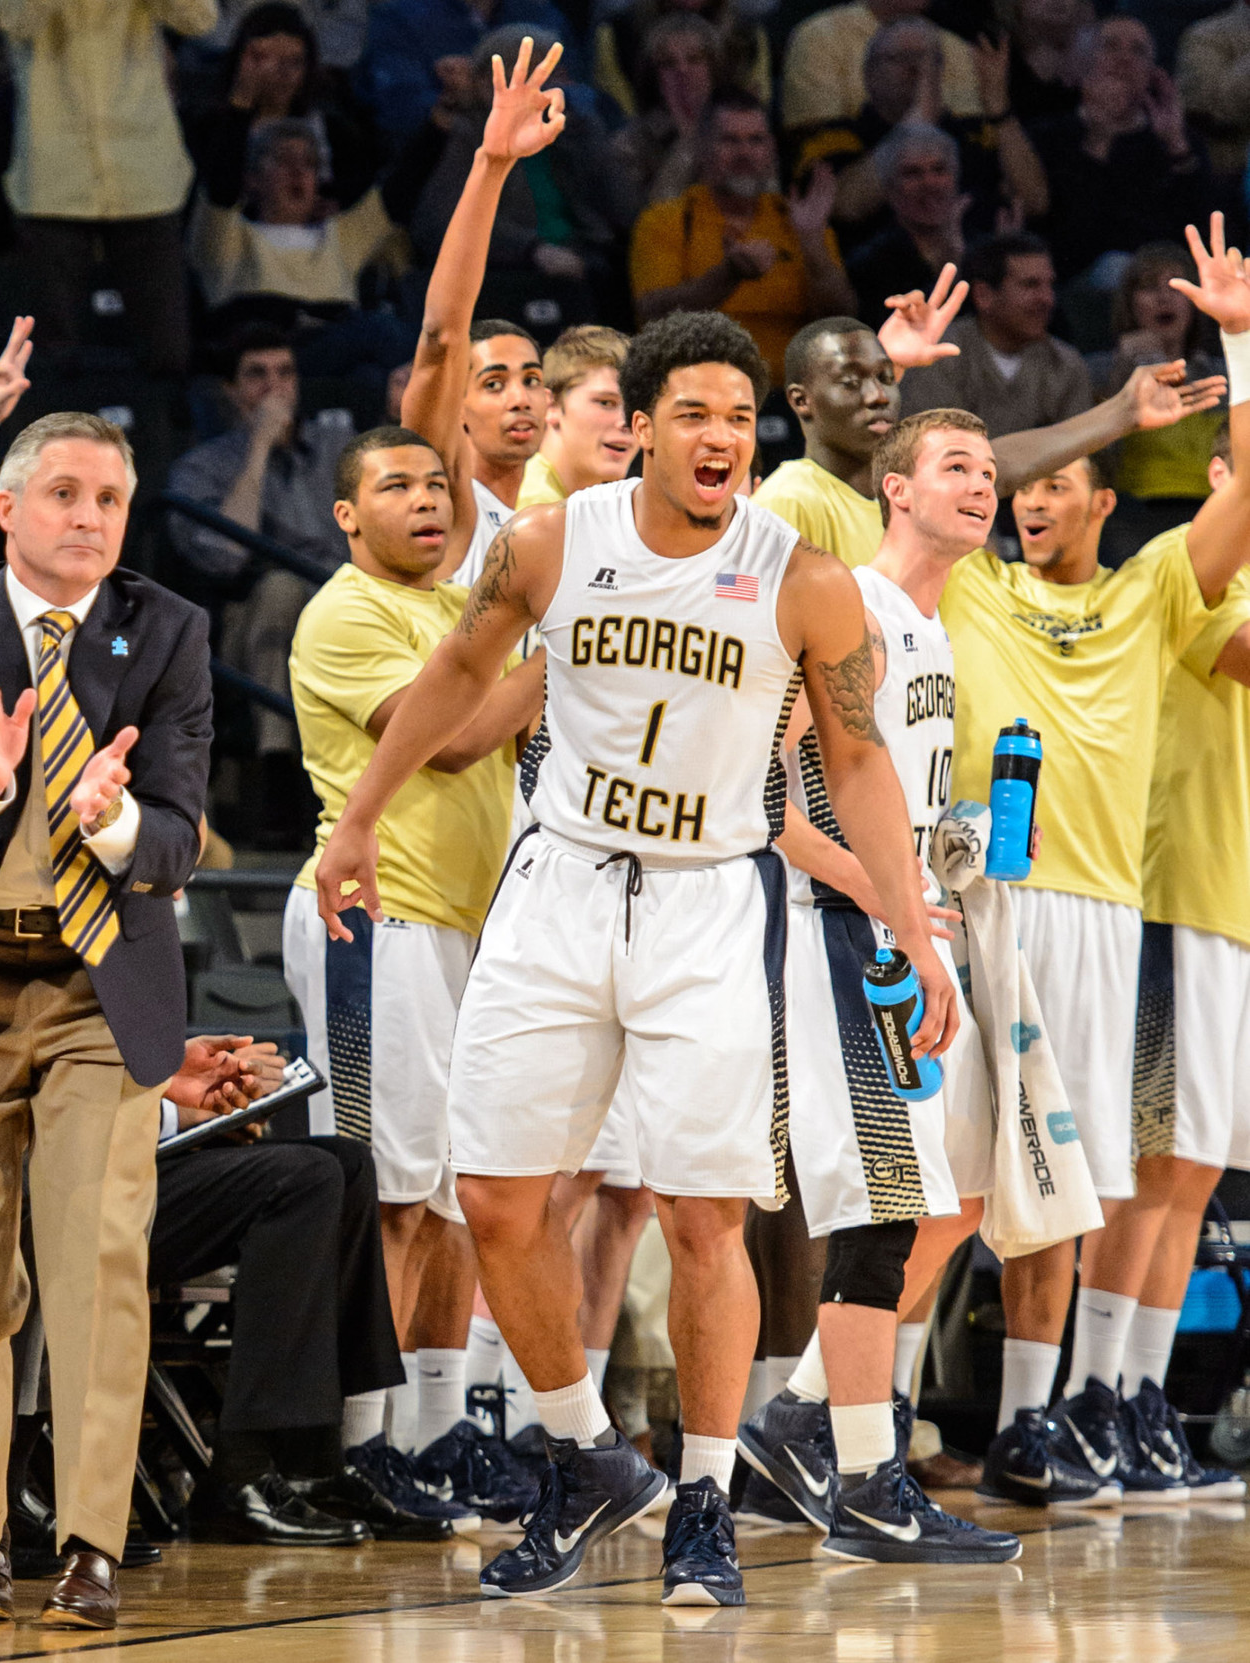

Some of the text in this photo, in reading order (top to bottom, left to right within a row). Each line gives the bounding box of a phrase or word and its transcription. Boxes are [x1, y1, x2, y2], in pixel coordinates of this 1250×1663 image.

[587, 582, 619, 591] RUSSELL
[572, 614, 746, 690] GEORGIA
[638, 699, 668, 767] 1
[905, 672, 955, 727] GEORG
[583, 762, 707, 842] TECH
[927, 746, 954, 808] 10
[880, 1010, 911, 1085] POWERADE
